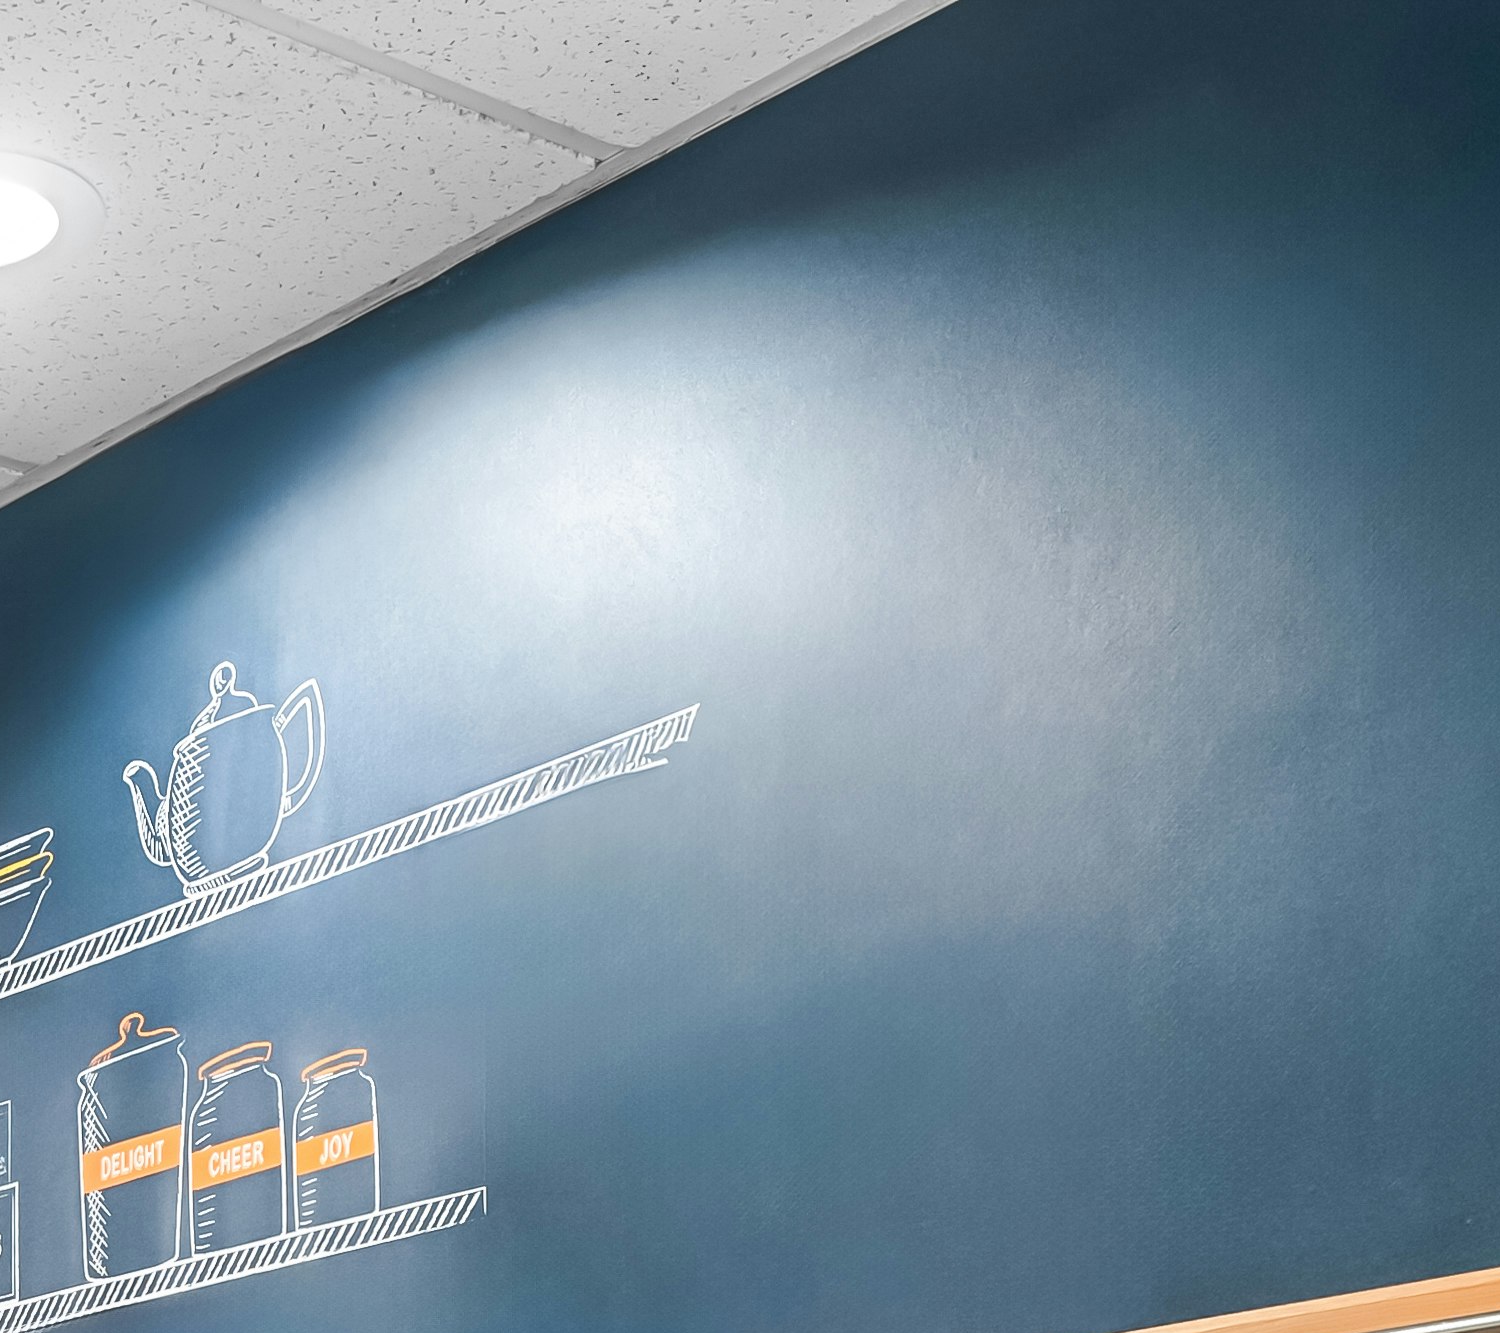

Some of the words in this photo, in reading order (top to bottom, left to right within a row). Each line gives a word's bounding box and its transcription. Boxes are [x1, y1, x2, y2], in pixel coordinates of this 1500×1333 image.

[100, 1140, 165, 1181] DELIGHT
[209, 1140, 264, 1178] CHEER
[319, 1131, 354, 1165] JOY
